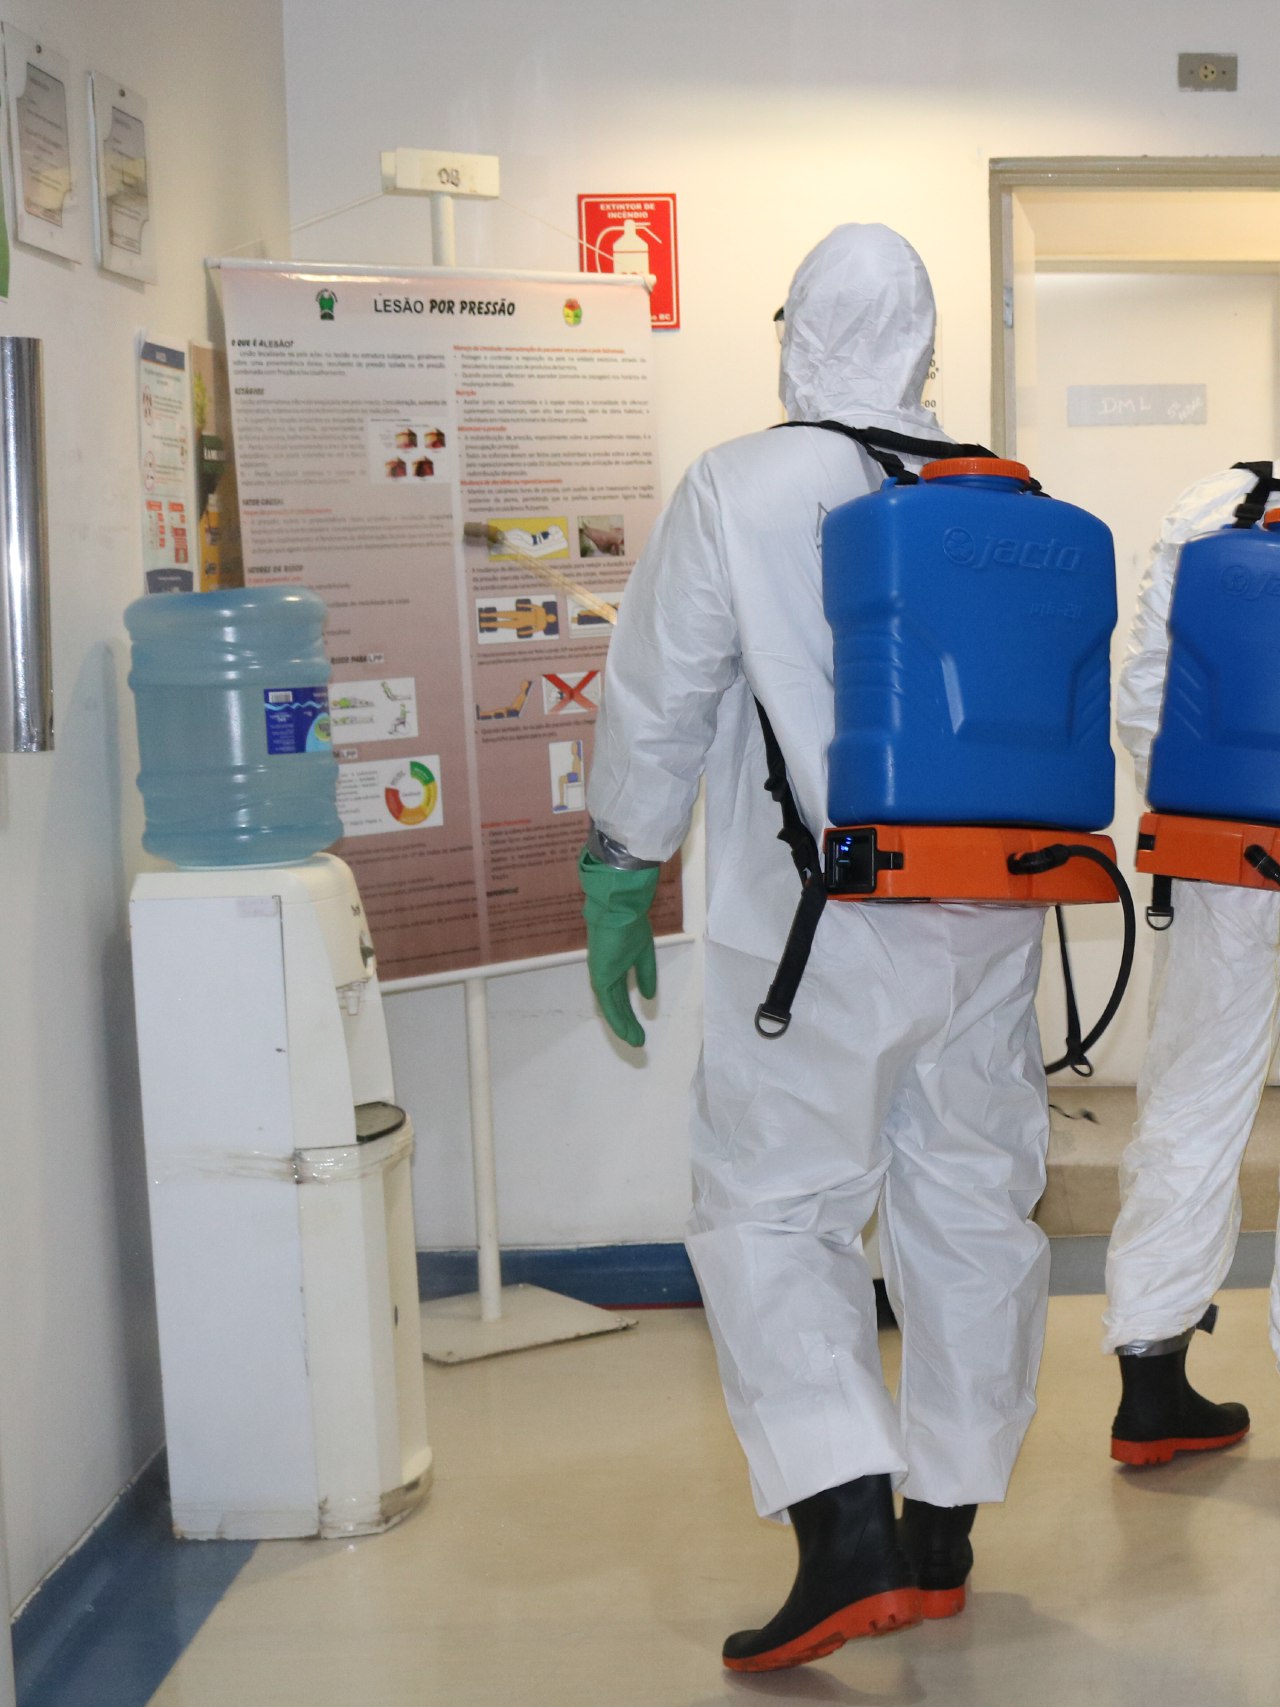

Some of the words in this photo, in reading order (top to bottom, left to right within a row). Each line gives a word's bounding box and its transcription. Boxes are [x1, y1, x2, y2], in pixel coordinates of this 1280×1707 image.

[599, 203, 643, 211] EXTINTOR
[607, 209, 649, 219] INCÊNDIO
[374, 297, 424, 314] LESÃO
[429, 298, 455, 315] POR
[459, 298, 515, 316] PRESSÃO
[975, 536, 1082, 570] jacto
